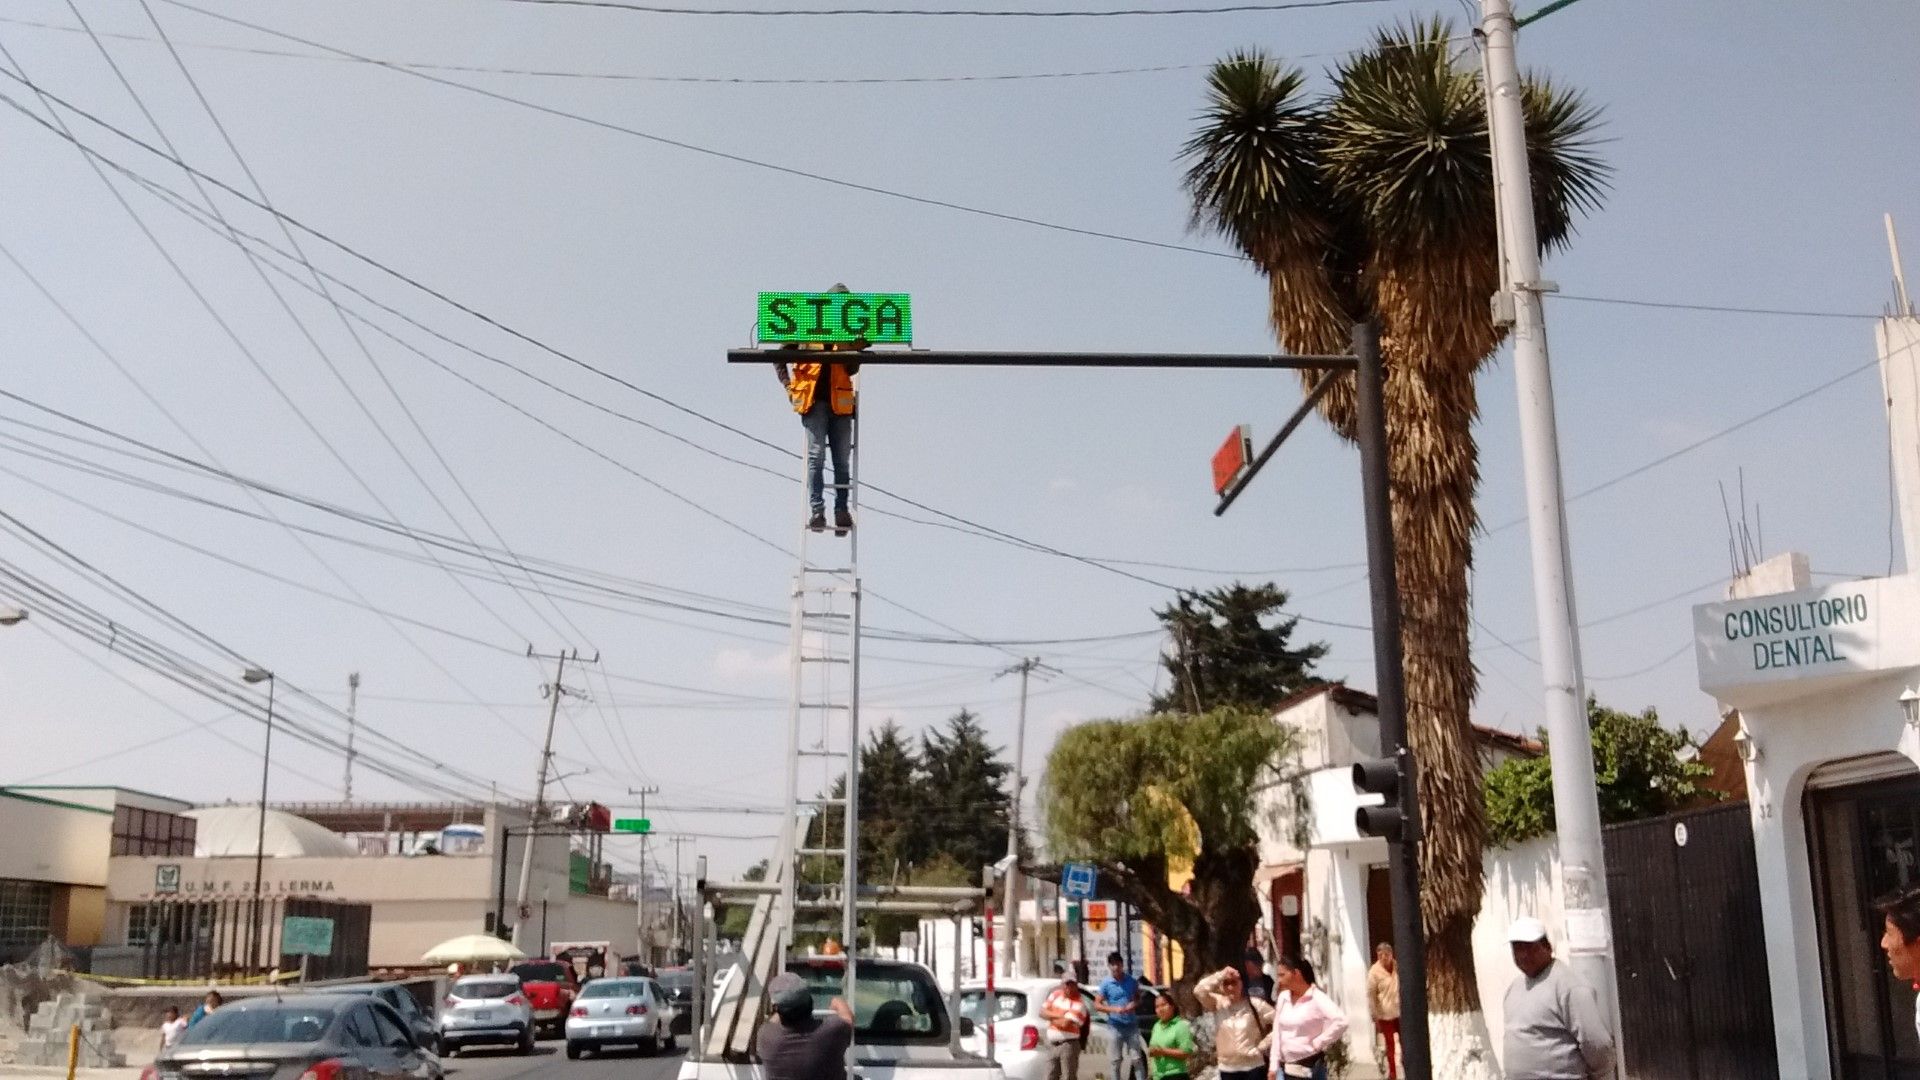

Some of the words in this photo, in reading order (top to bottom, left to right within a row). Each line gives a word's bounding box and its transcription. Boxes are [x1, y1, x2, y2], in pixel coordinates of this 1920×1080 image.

[767, 298, 903, 336] SIGA
[1724, 593, 1868, 641] CONSULTORIO
[1753, 634, 1847, 671] DENTAL
[279, 880, 335, 892] LERMA
